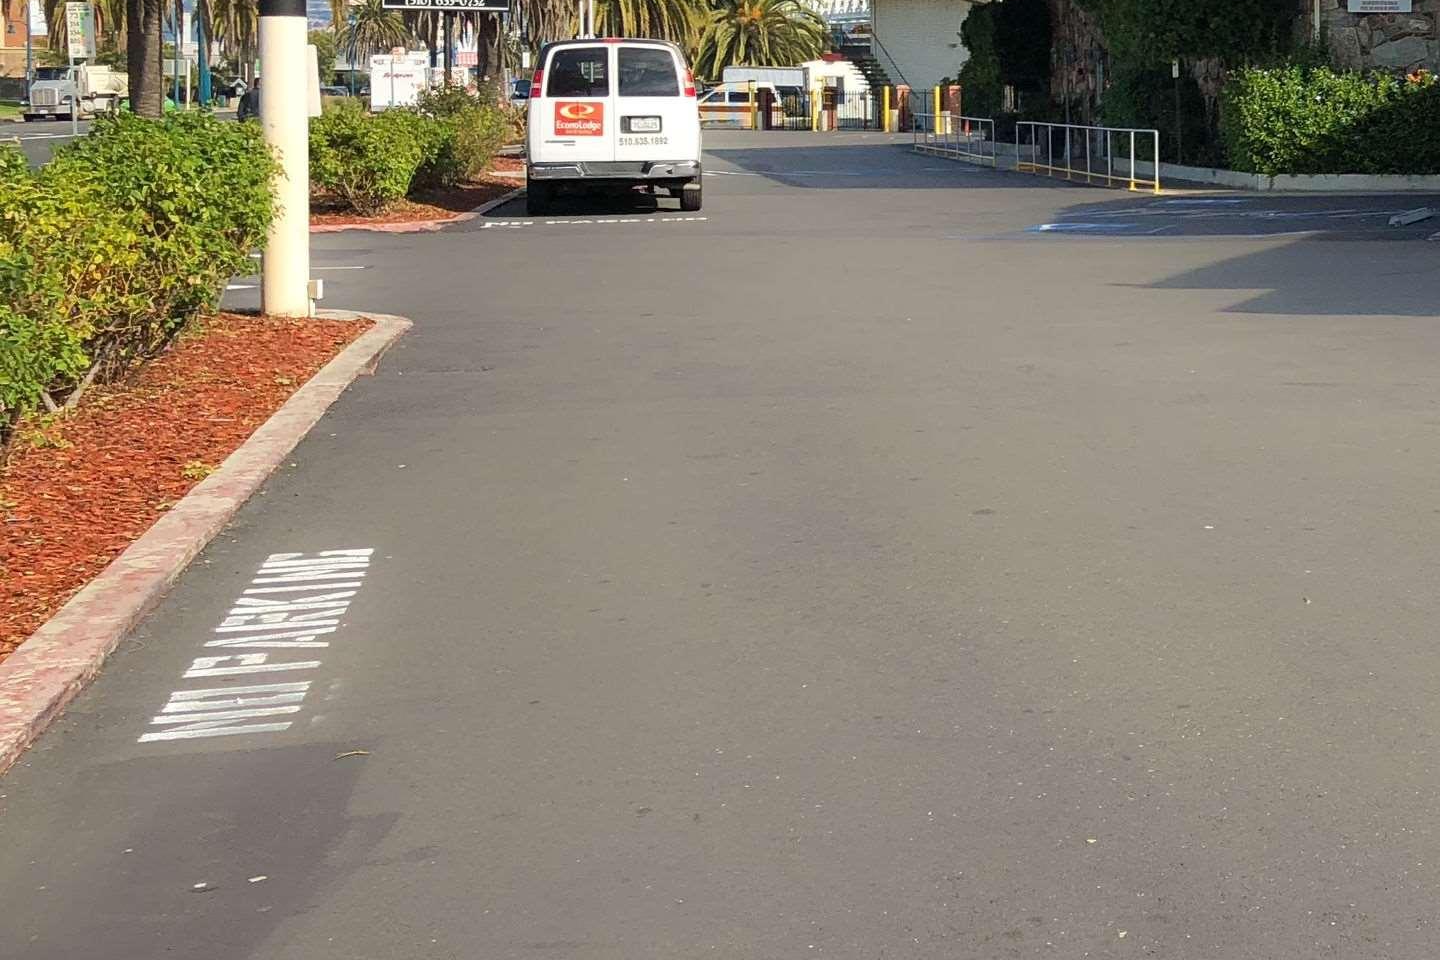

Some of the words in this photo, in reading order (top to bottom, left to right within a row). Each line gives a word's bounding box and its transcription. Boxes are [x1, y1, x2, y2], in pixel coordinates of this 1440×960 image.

[556, 119, 601, 131] EconoLodge
[182, 548, 375, 679] PARKING
[137, 681, 312, 743] NO
